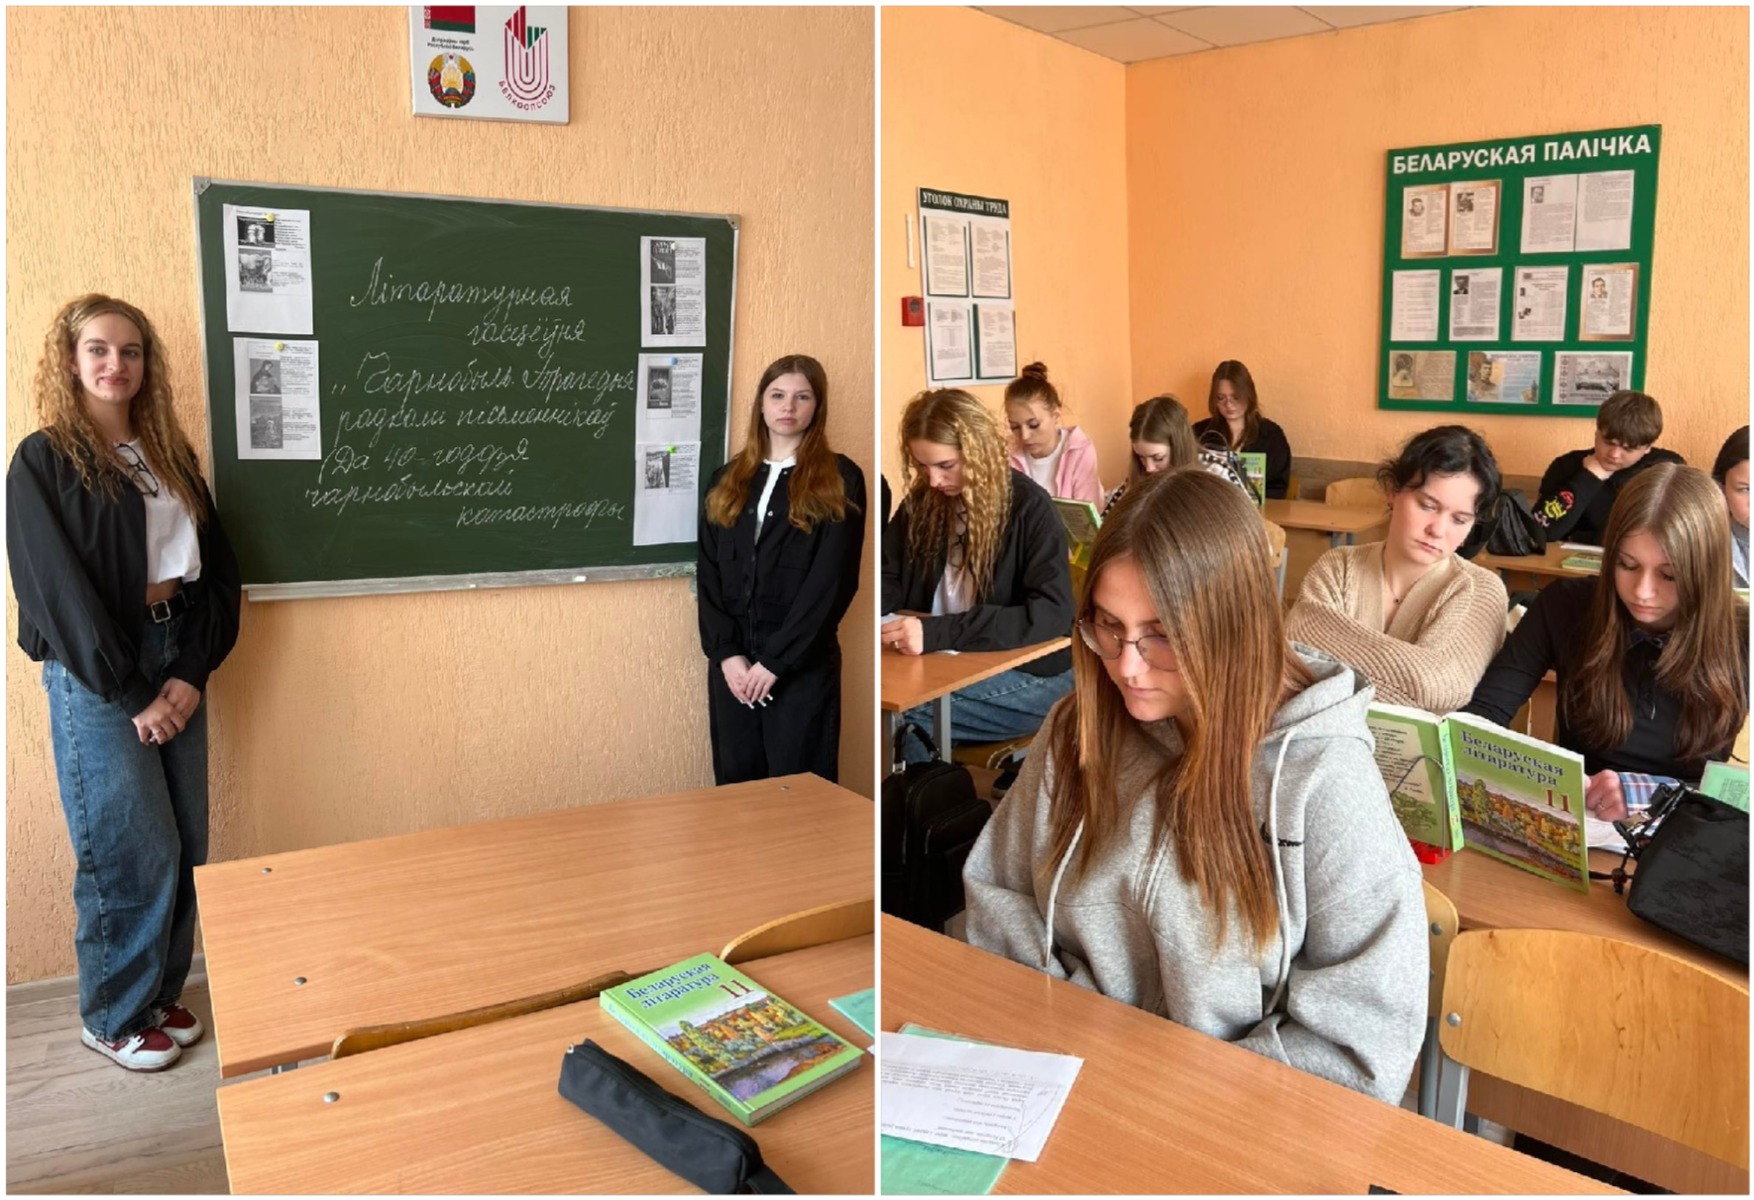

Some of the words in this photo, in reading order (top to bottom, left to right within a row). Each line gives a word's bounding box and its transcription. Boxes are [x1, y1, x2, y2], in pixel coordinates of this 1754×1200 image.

[498, 80, 556, 111] БЕЛКООПСОЮЗ
[1393, 144, 1536, 175] БЕЛАРУСКАЯ
[1544, 134, 1652, 162] ПАЛІЧКА
[922, 191, 953, 207] УГОЛОК
[953, 196, 985, 211] ОХРАНЫ
[985, 201, 1007, 215] ТРУДА
[350, 256, 573, 324] Літаратурная
[456, 499, 625, 530] катастрофы
[1461, 729, 1564, 776] Беларуская
[1463, 746, 1558, 788] літаратура
[1545, 788, 1570, 812] 11
[626, 961, 713, 1001] Беларуская
[641, 972, 720, 1010] літаратура
[719, 979, 755, 1000] 11
